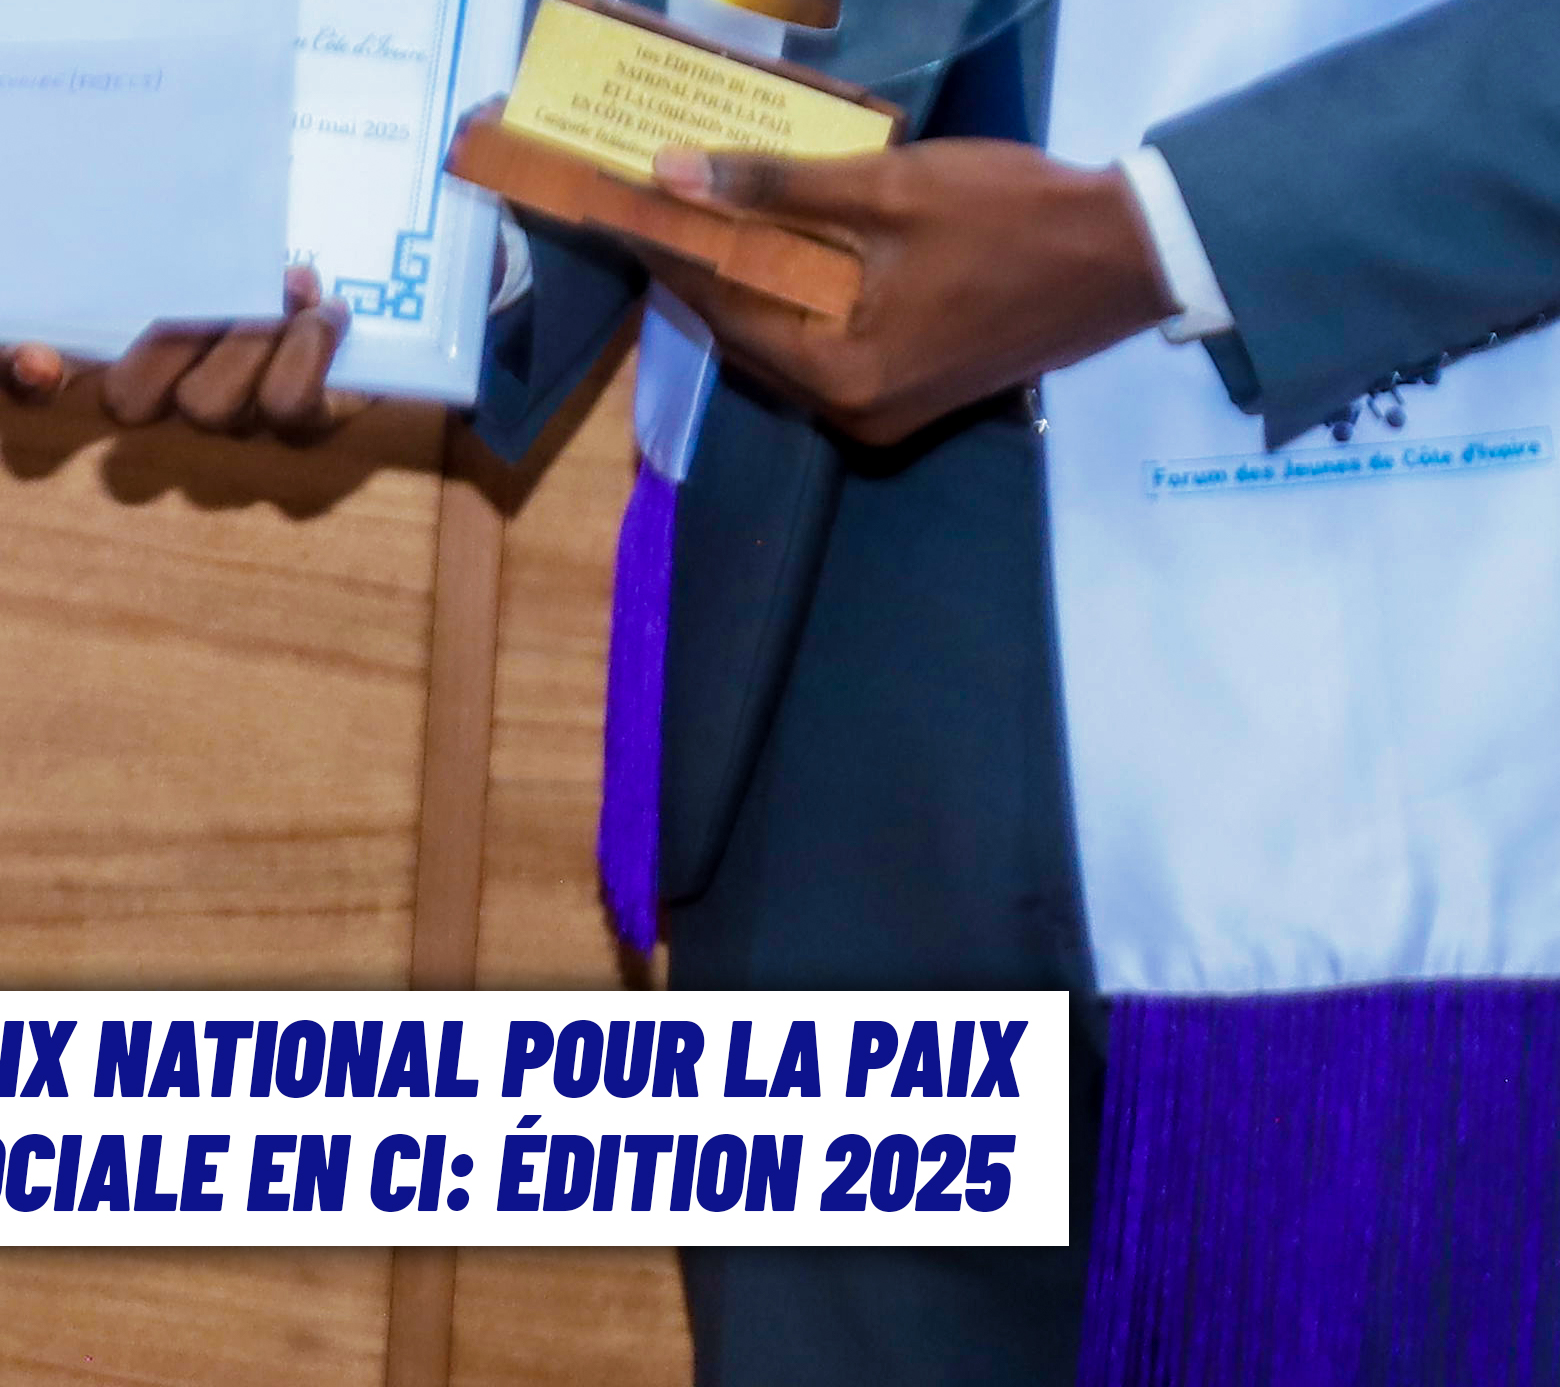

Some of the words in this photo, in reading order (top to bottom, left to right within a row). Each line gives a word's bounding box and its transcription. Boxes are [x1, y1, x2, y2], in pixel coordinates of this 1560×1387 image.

[364, 119, 411, 140] 2025
[1153, 464, 1227, 488] Forum
[1235, 460, 1275, 482] des
[1284, 456, 1361, 480] Jeunes
[1369, 453, 1395, 470] de
